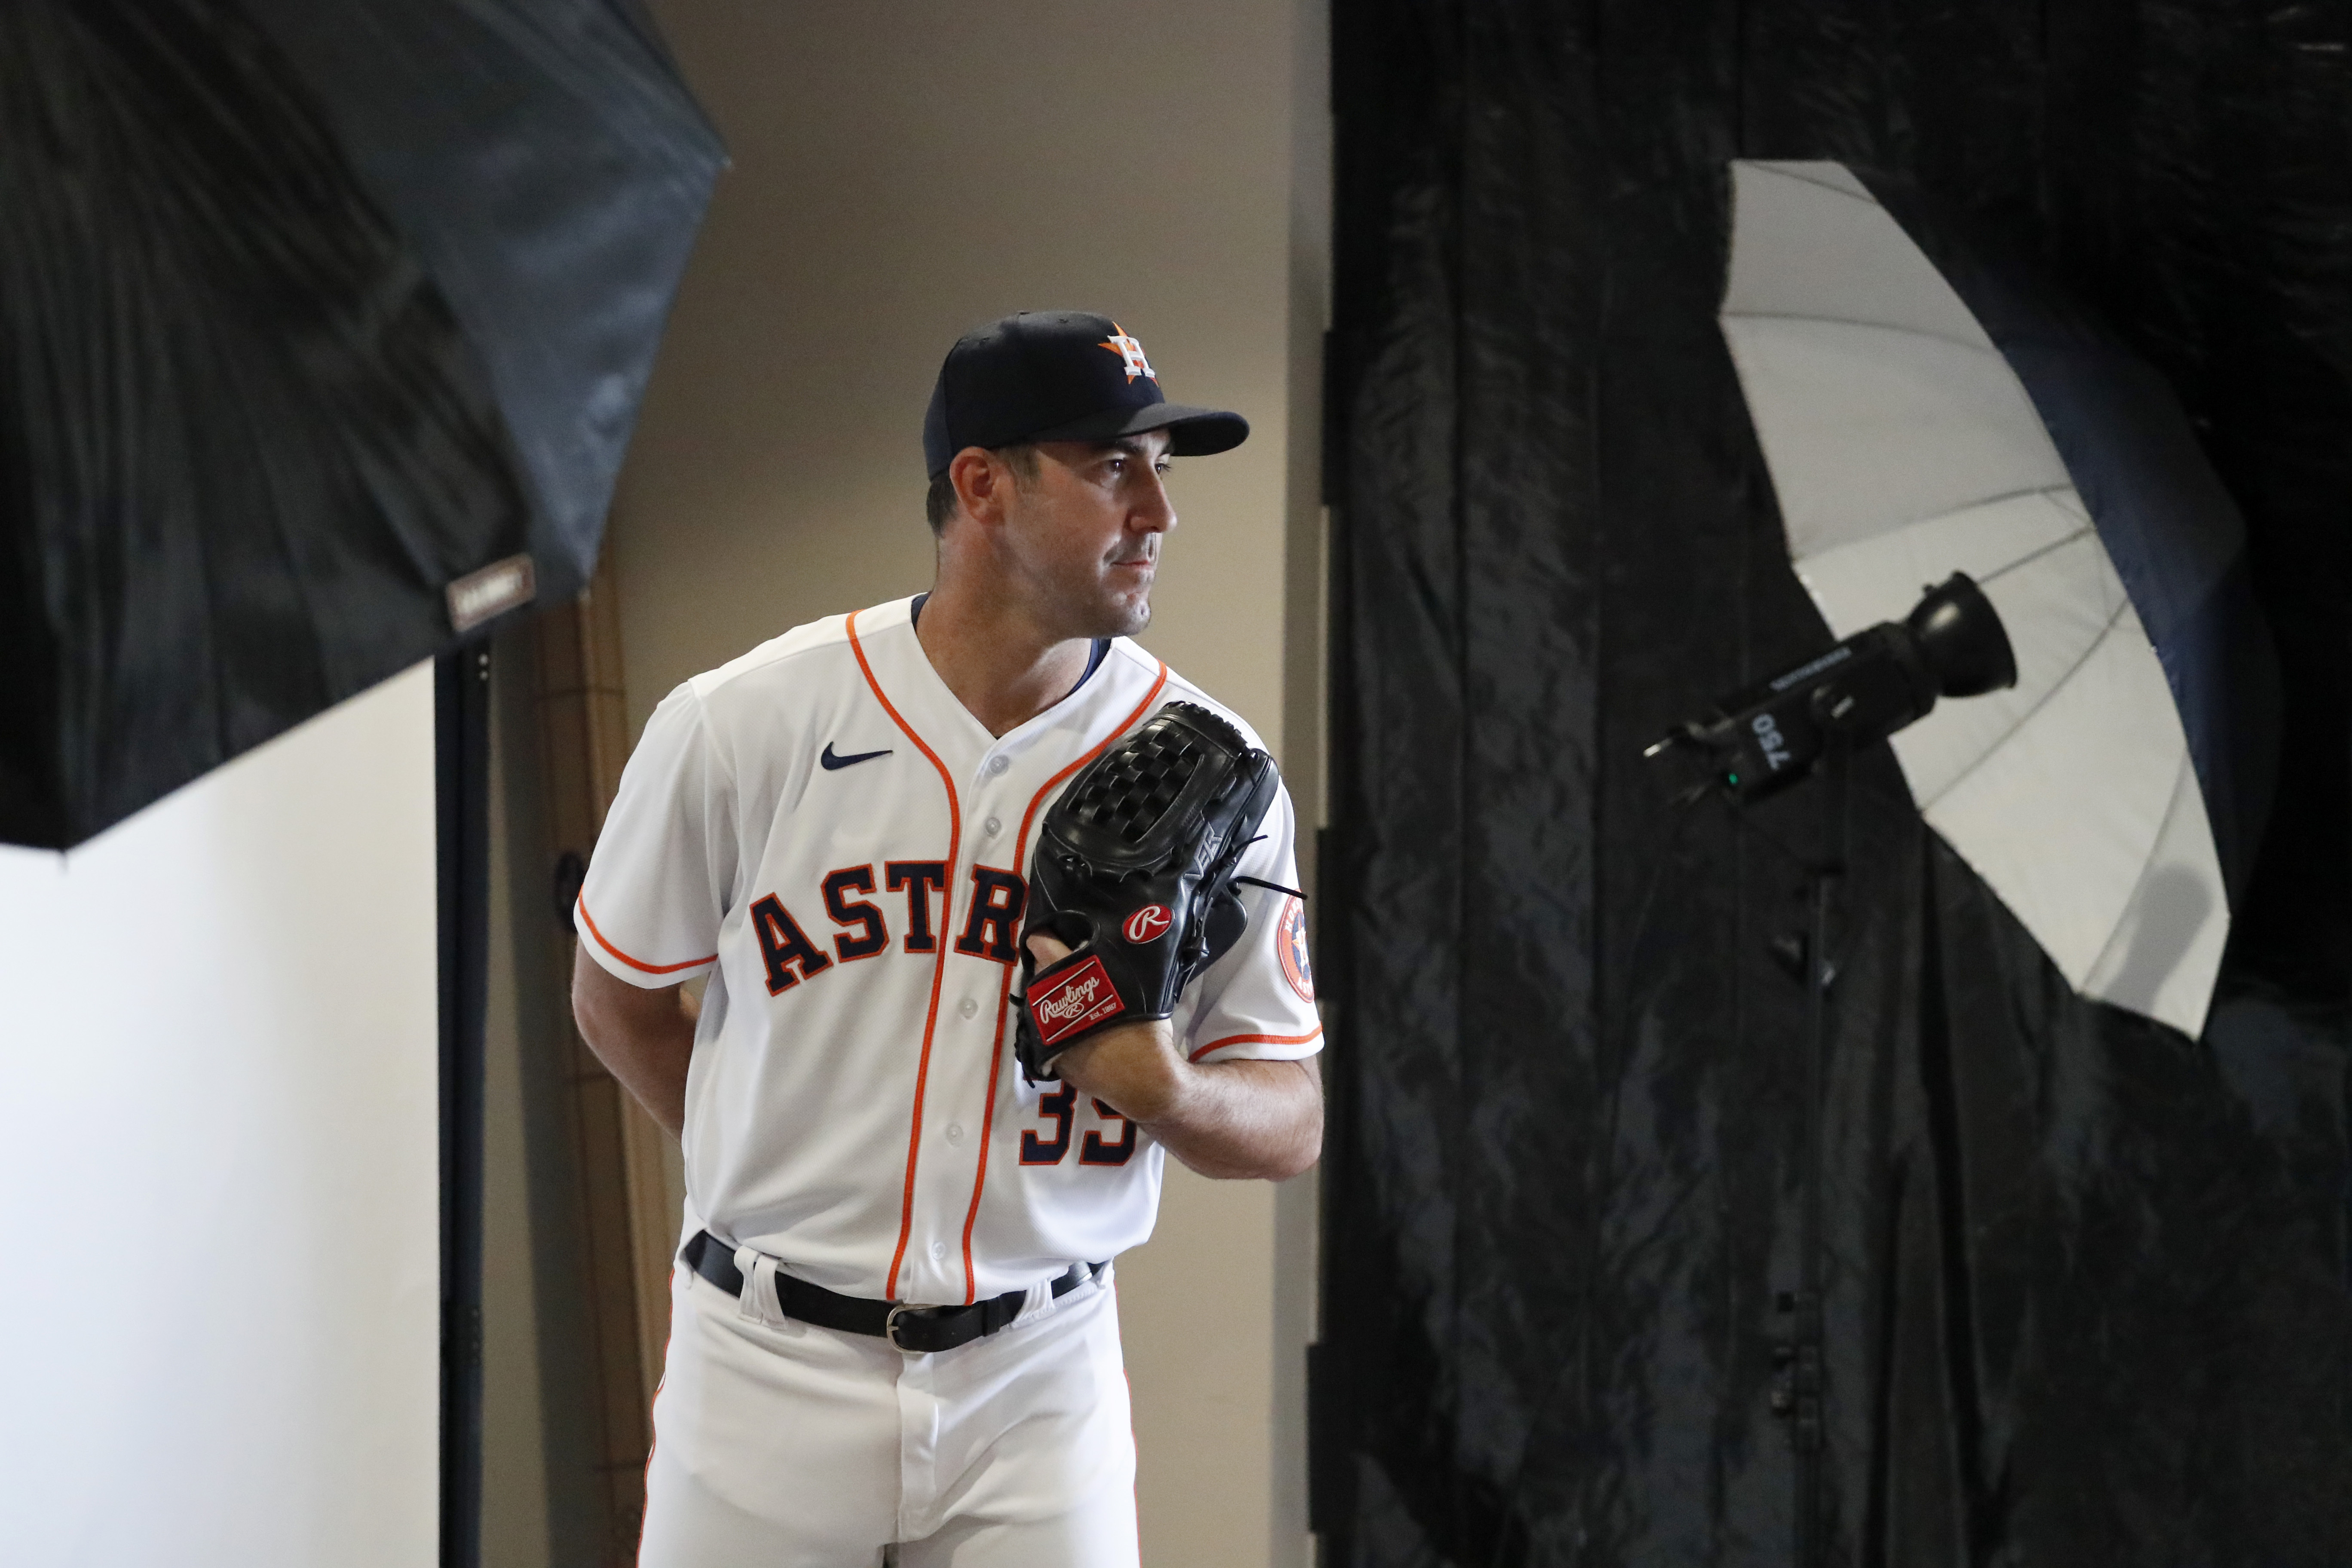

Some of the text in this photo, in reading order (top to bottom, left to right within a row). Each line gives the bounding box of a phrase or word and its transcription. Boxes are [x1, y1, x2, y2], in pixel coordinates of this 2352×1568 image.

[1107, 335, 1155, 377] H
[1752, 714, 1791, 770] 750
[1129, 906, 1169, 940] R
[1040, 977, 1099, 1024] Rawlings
[1089, 1002, 1116, 1020] Est. 1887
